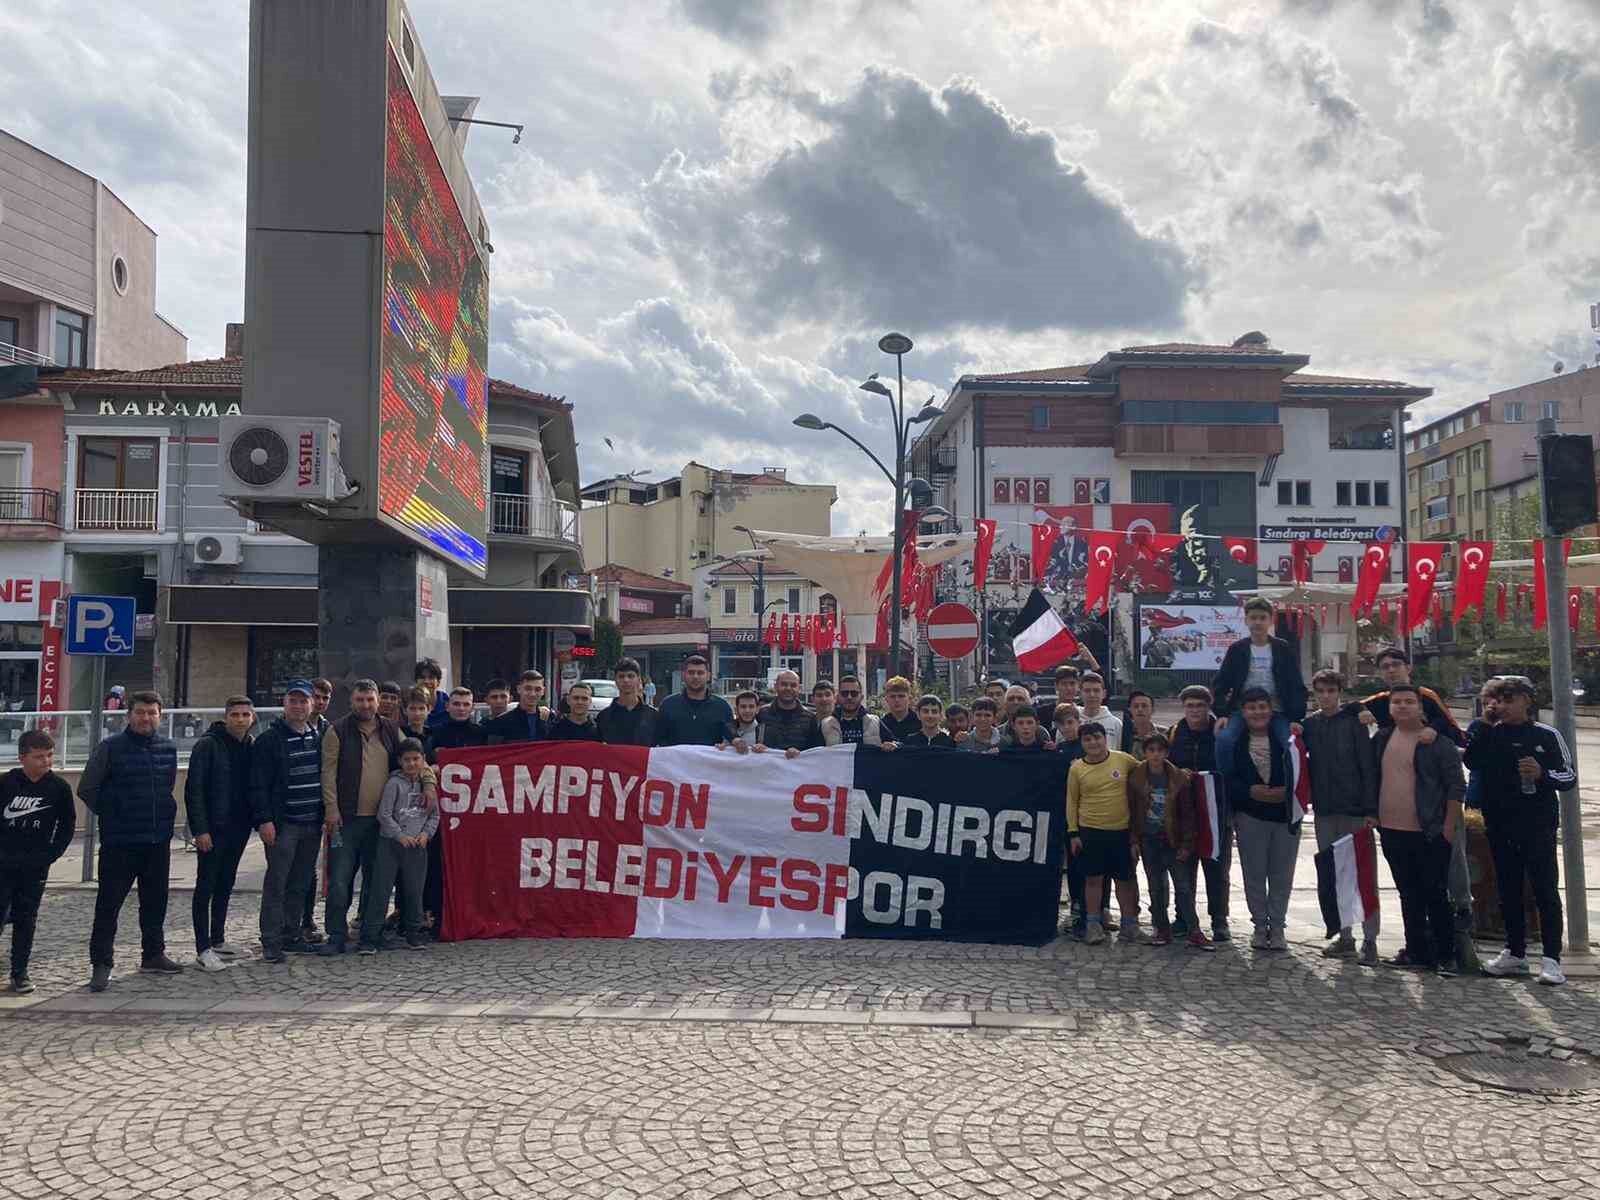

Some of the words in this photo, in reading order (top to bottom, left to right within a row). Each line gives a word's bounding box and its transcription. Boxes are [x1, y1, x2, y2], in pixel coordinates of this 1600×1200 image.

[298, 431, 313, 487] VESTEL
[1314, 527, 1374, 541] Belediyesi
[75, 601, 114, 643] P
[10, 796, 43, 809] NIKE
[791, 784, 1050, 864] SINDIRGI
